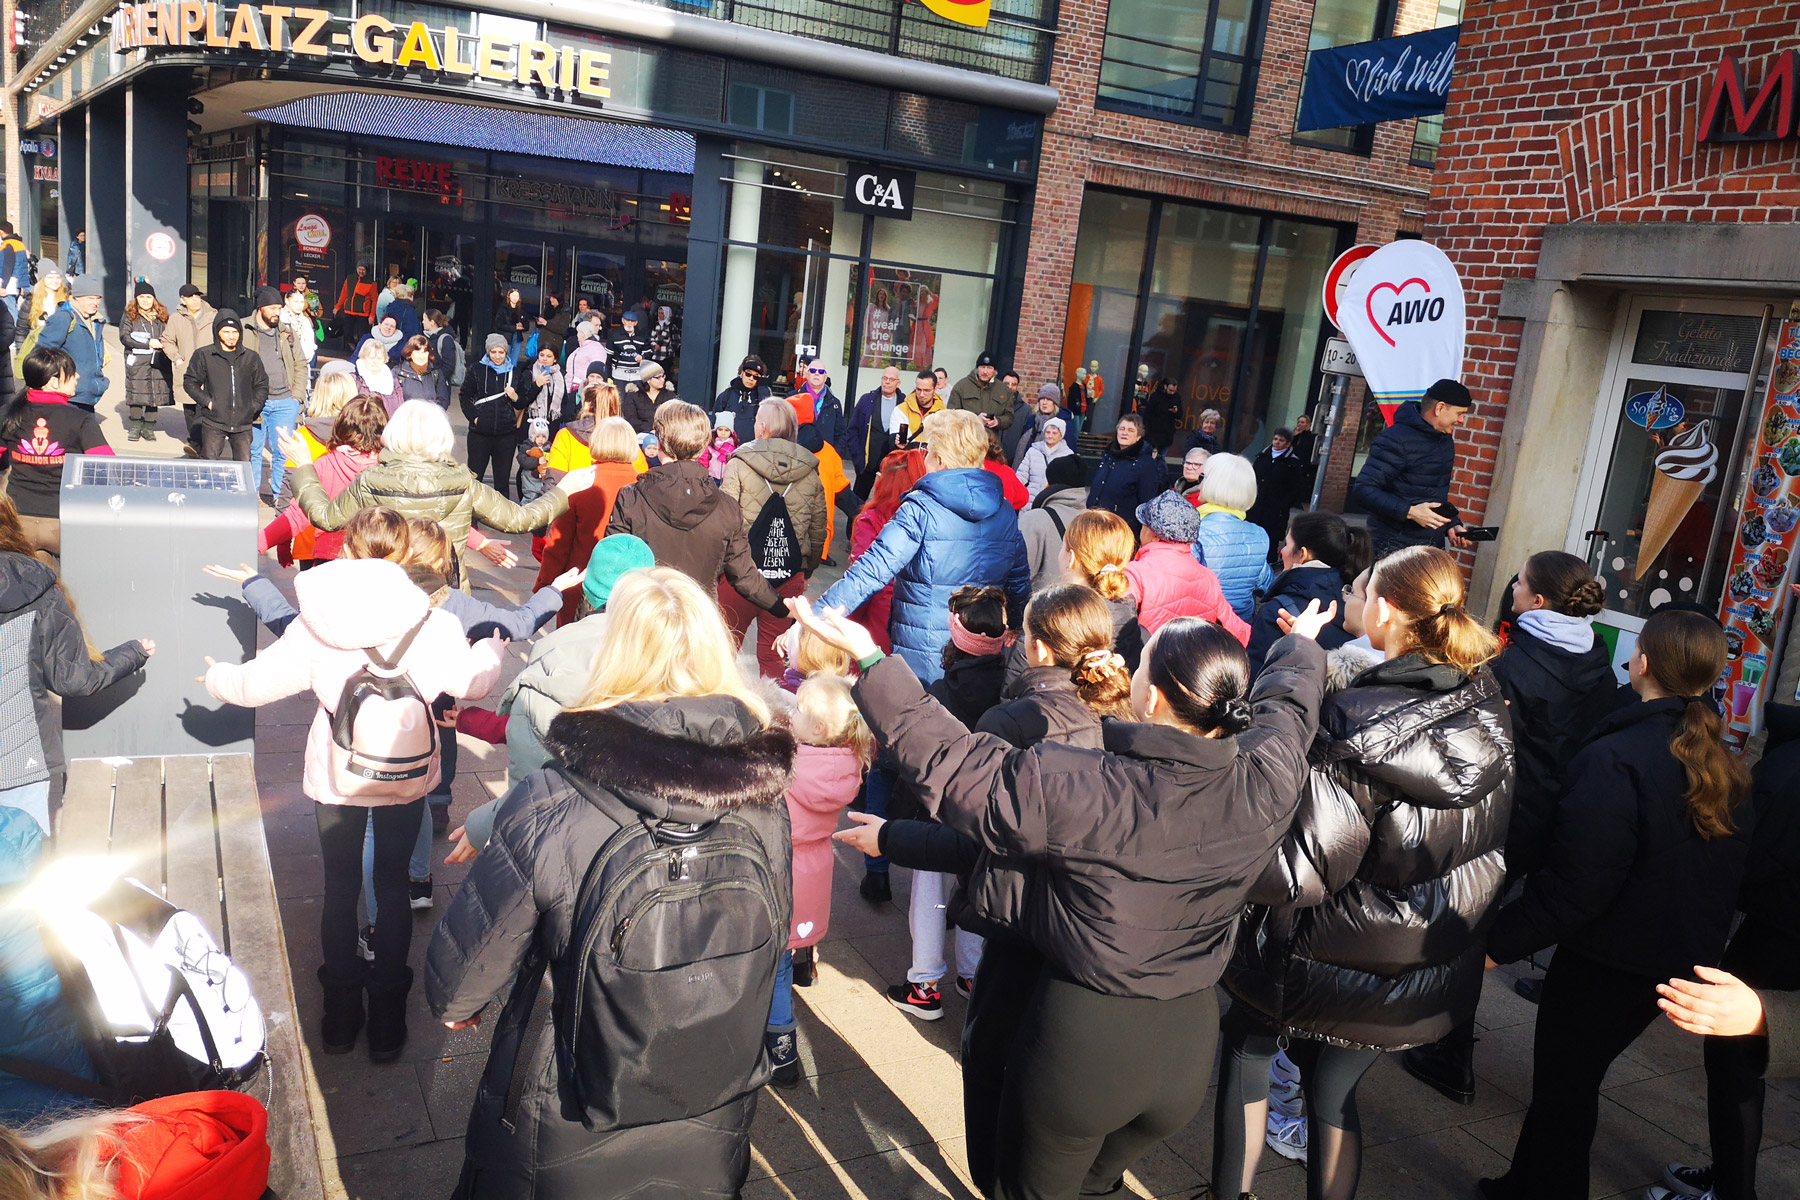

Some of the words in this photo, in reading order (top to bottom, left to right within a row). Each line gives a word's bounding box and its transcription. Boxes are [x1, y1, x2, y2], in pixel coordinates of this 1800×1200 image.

[1697, 49, 1800, 142] M
[20, 140, 39, 155] Apollo
[376, 155, 452, 187] REWE
[494, 177, 615, 210] KRESSMANN
[855, 174, 905, 210] C&A
[510, 275, 538, 286] GALERIE
[581, 285, 608, 294] GALERIE
[1386, 297, 1445, 326] AWO
[871, 329, 889, 341] the
[872, 321, 899, 331] wear
[1678, 319, 1723, 343] Gelato
[870, 340, 909, 356] change
[1327, 349, 1338, 361] 10
[1345, 352, 1356, 365] 20
[1649, 340, 1742, 370] Tradizionale
[1192, 376, 1232, 403] love
[375, 771, 409, 781] Instagram
